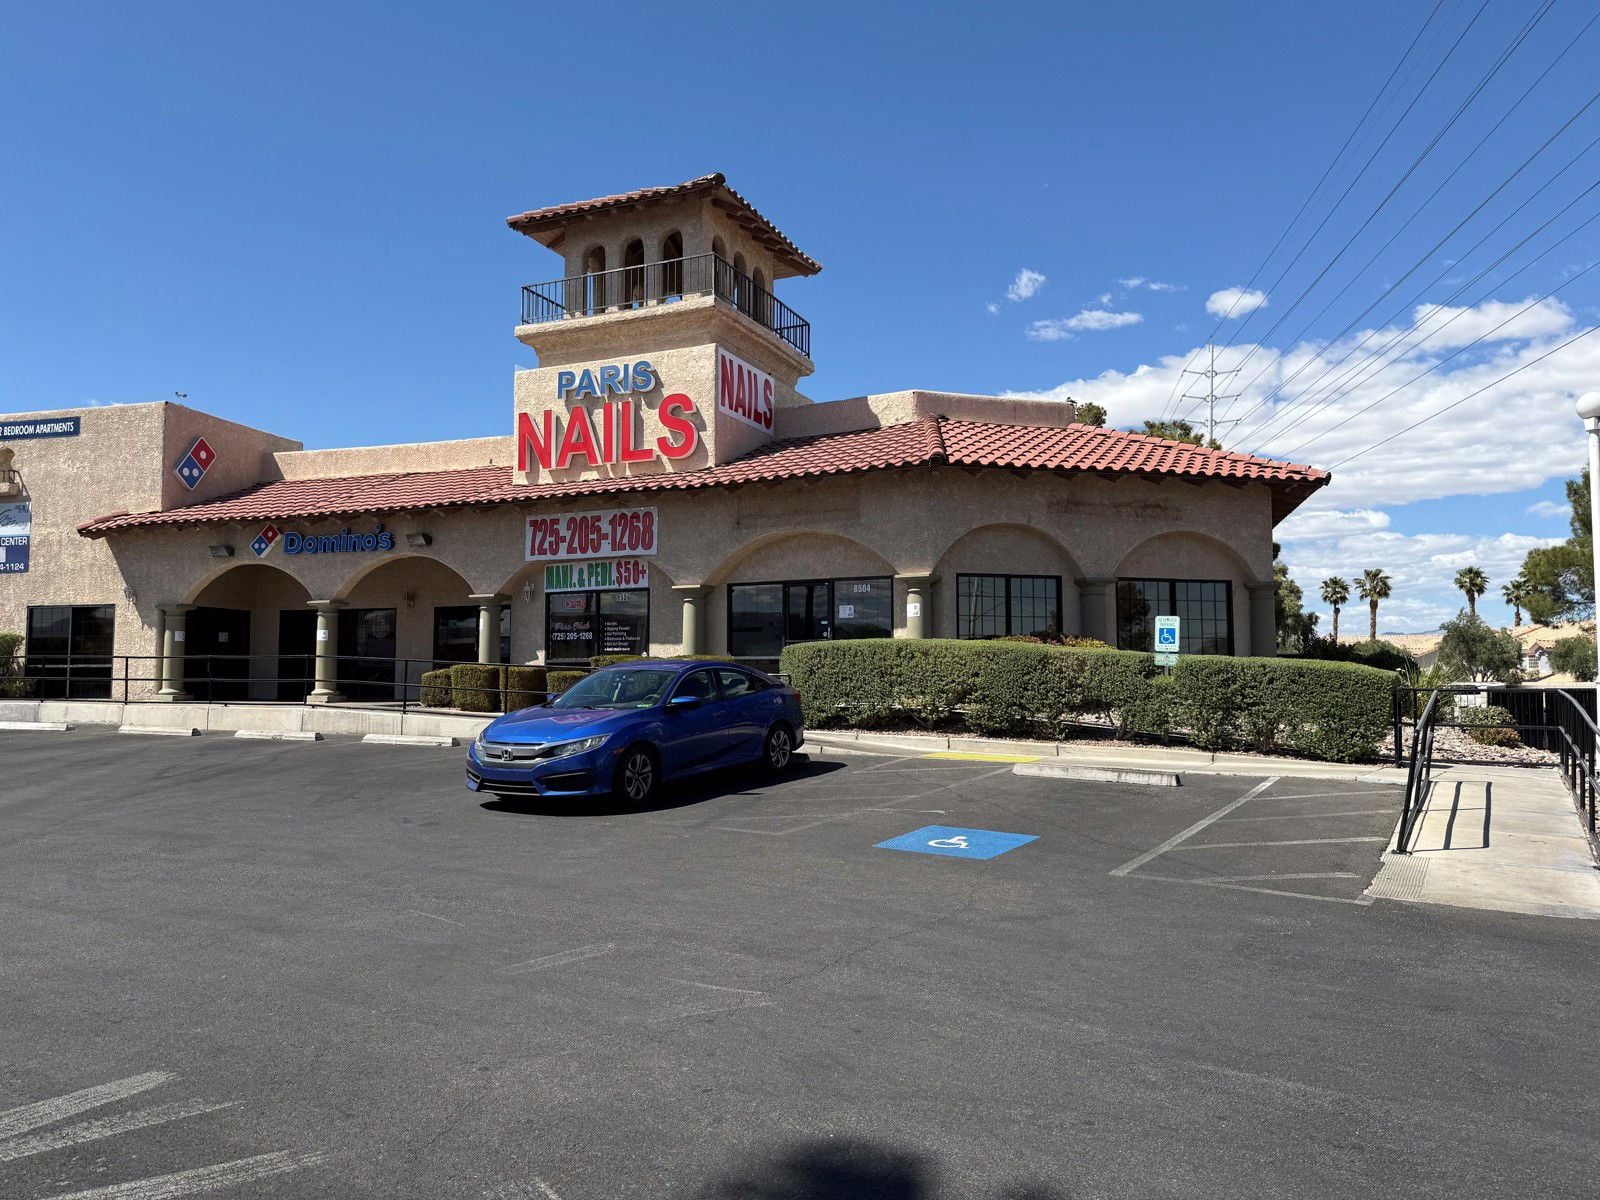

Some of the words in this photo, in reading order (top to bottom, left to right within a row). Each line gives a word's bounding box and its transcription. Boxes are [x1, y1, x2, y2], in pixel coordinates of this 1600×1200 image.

[557, 360, 655, 400] PARIS
[720, 353, 773, 430] NAILS
[3, 425, 35, 436] BEDROOM
[35, 421, 74, 434] APARTMENTS
[517, 392, 698, 472] NAILS
[1, 537, 28, 546] CENTER
[283, 523, 394, 554] Domino's
[529, 511, 655, 557] 725-205-1268
[577, 566, 586, 588] &
[615, 559, 647, 587] $50+
[853, 584, 871, 593] 8504
[566, 631, 593, 640] 205-1268
